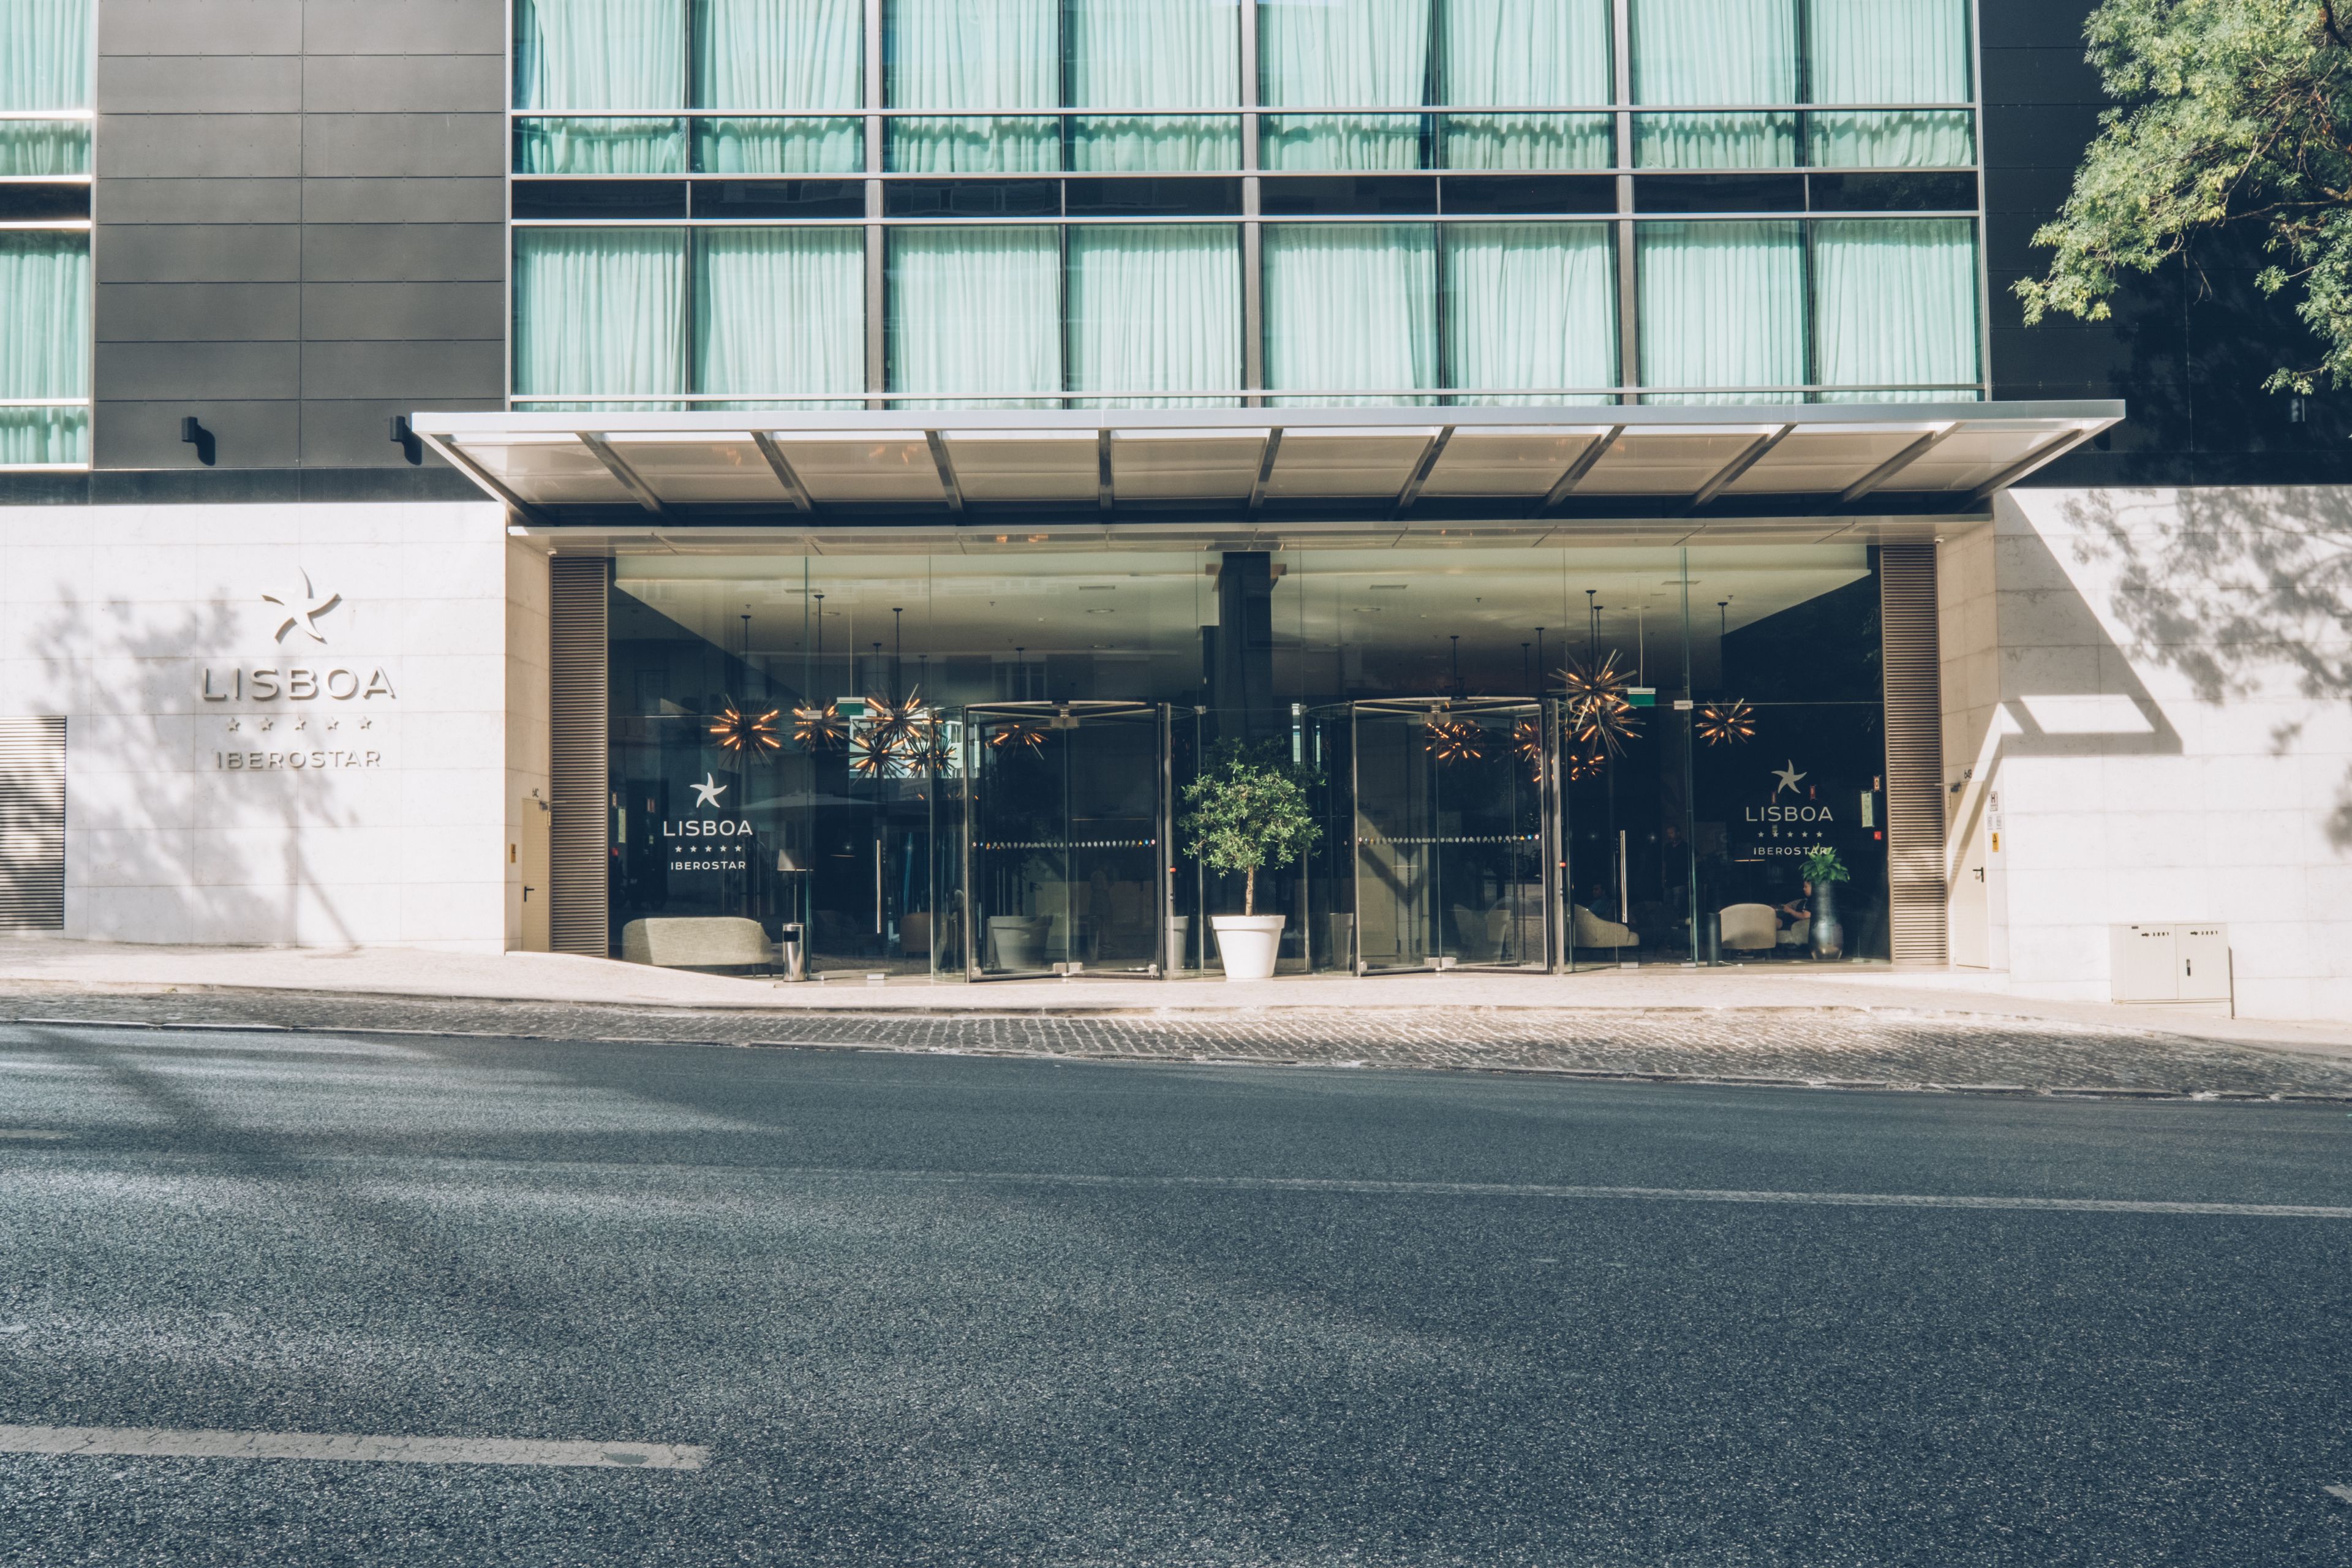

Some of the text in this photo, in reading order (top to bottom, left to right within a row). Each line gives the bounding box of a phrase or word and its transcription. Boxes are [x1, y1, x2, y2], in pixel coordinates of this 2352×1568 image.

[202, 666, 396, 701] LISBOA
[216, 750, 382, 769] IBEROSTAR
[1746, 806, 1834, 822] LISBOA
[663, 820, 753, 837] LISBOA
[671, 861, 746, 870] IBEROSTAR
